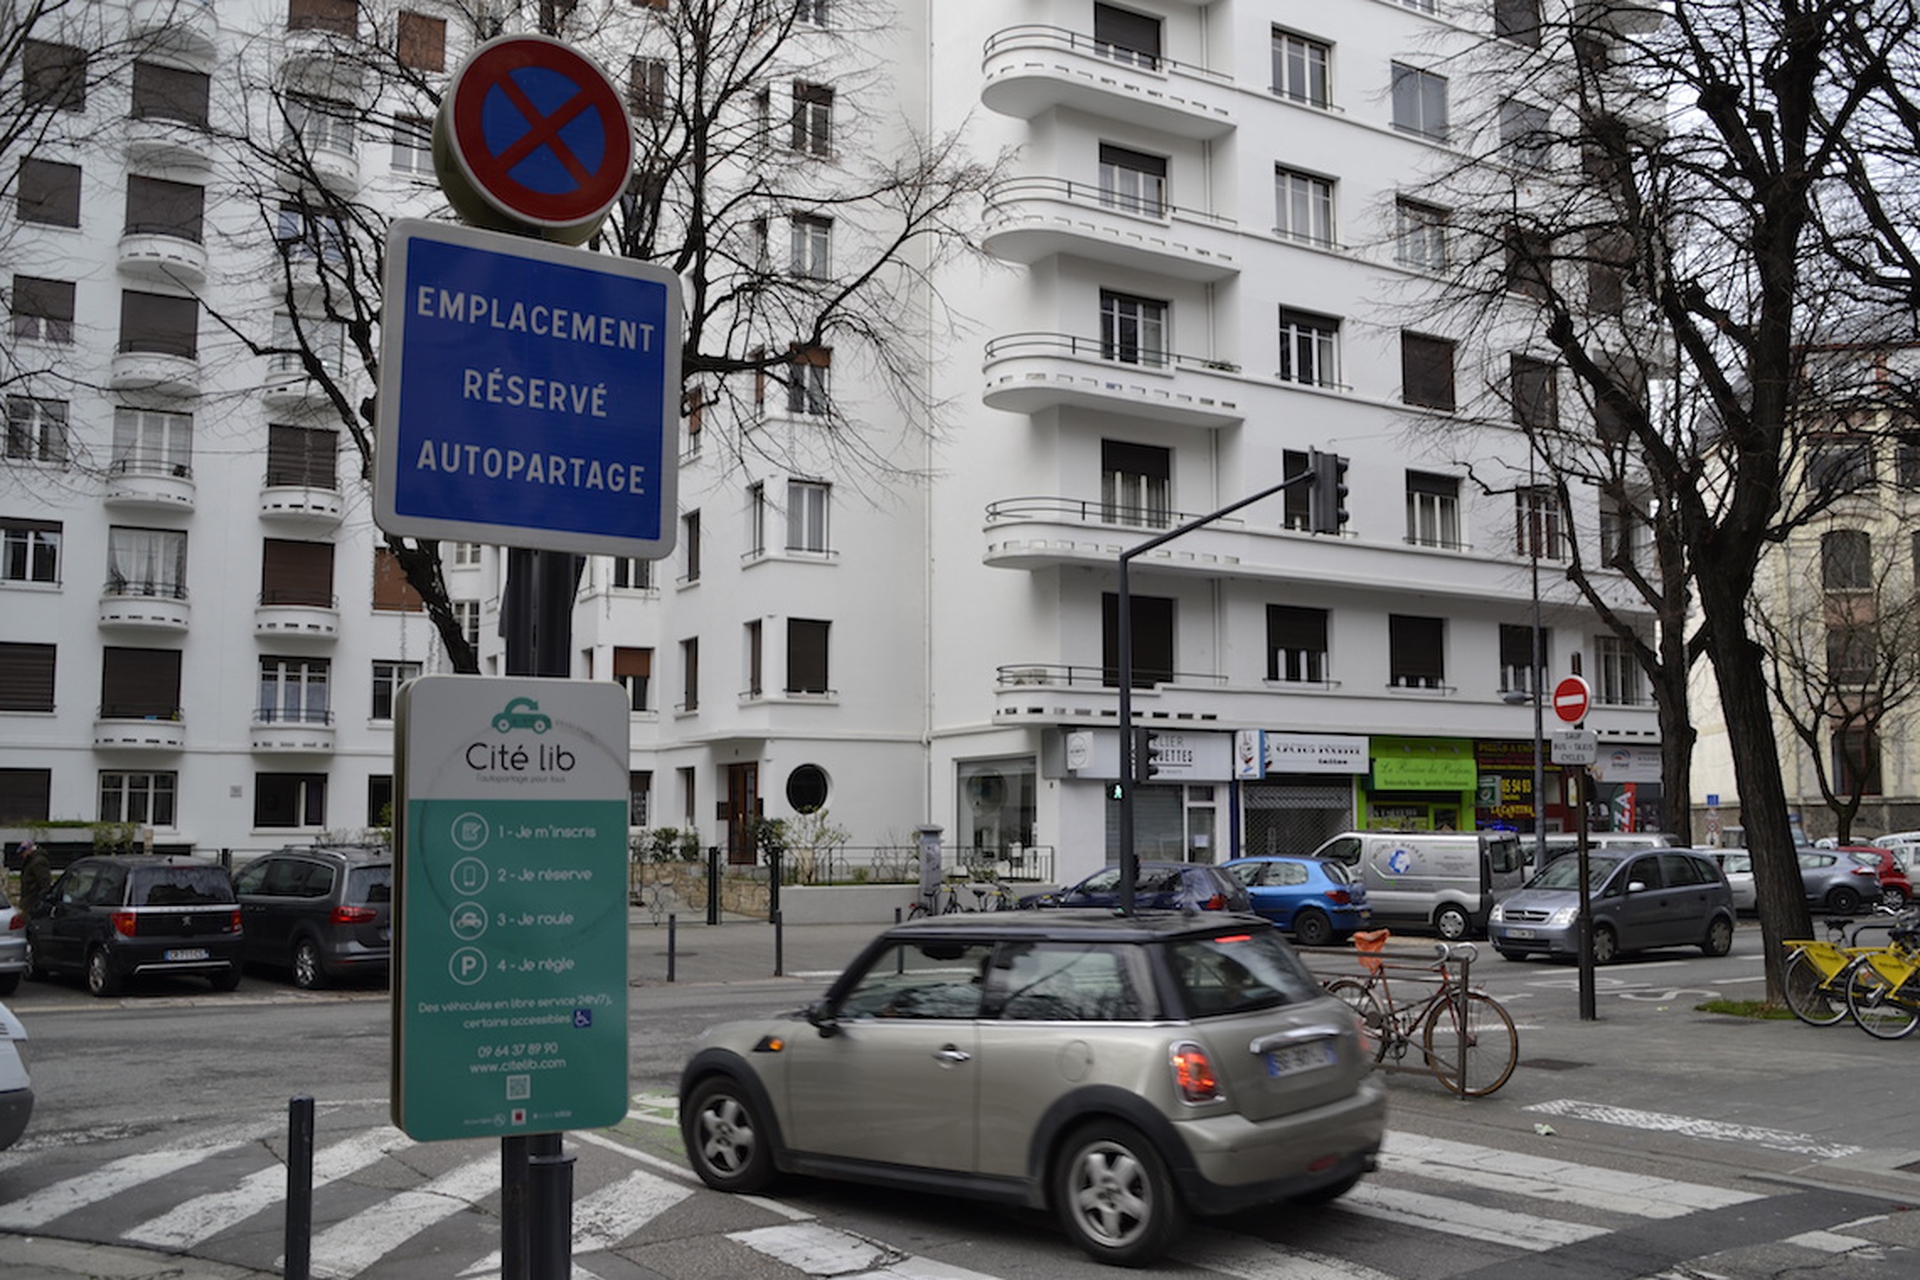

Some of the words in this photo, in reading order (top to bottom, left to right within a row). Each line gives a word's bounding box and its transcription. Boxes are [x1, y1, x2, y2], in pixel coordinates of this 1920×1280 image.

[416, 286, 654, 352] EMPLACEMENT
[464, 368, 607, 418] RÉSERVÉ
[416, 440, 646, 494] AUTOPARTAGE
[1564, 732, 1582, 740] SAUF
[466, 742, 529, 772] Cité
[540, 744, 576, 772] lib
[1561, 754, 1586, 762] CYCLES
[530, 776, 548, 784] pour
[550, 775, 566, 784] tous
[498, 826, 504, 838] 1
[516, 826, 532, 838] Je
[536, 825, 596, 838] m'inscris
[498, 868, 507, 881] 2
[518, 868, 535, 881] Je
[538, 868, 593, 880] réserve
[497, 914, 506, 926] 3
[518, 914, 534, 926] Je
[537, 912, 574, 926] roule
[497, 959, 507, 971] 4
[518, 959, 536, 972] Je
[538, 958, 575, 974] règle
[418, 1002, 440, 1014] Des
[441, 998, 493, 1012] véhicules
[494, 998, 509, 1009] en
[510, 996, 535, 1008] libre
[538, 995, 575, 1008] service
[463, 1016, 509, 1030] certains
[511, 1013, 570, 1028] accessibles
[477, 1046, 493, 1058] 09
[494, 1044, 509, 1057] 64
[511, 1044, 525, 1056] 37
[527, 1042, 542, 1056] 89
[543, 1042, 558, 1054] 90
[469, 1058, 567, 1074] www.citelib.com
